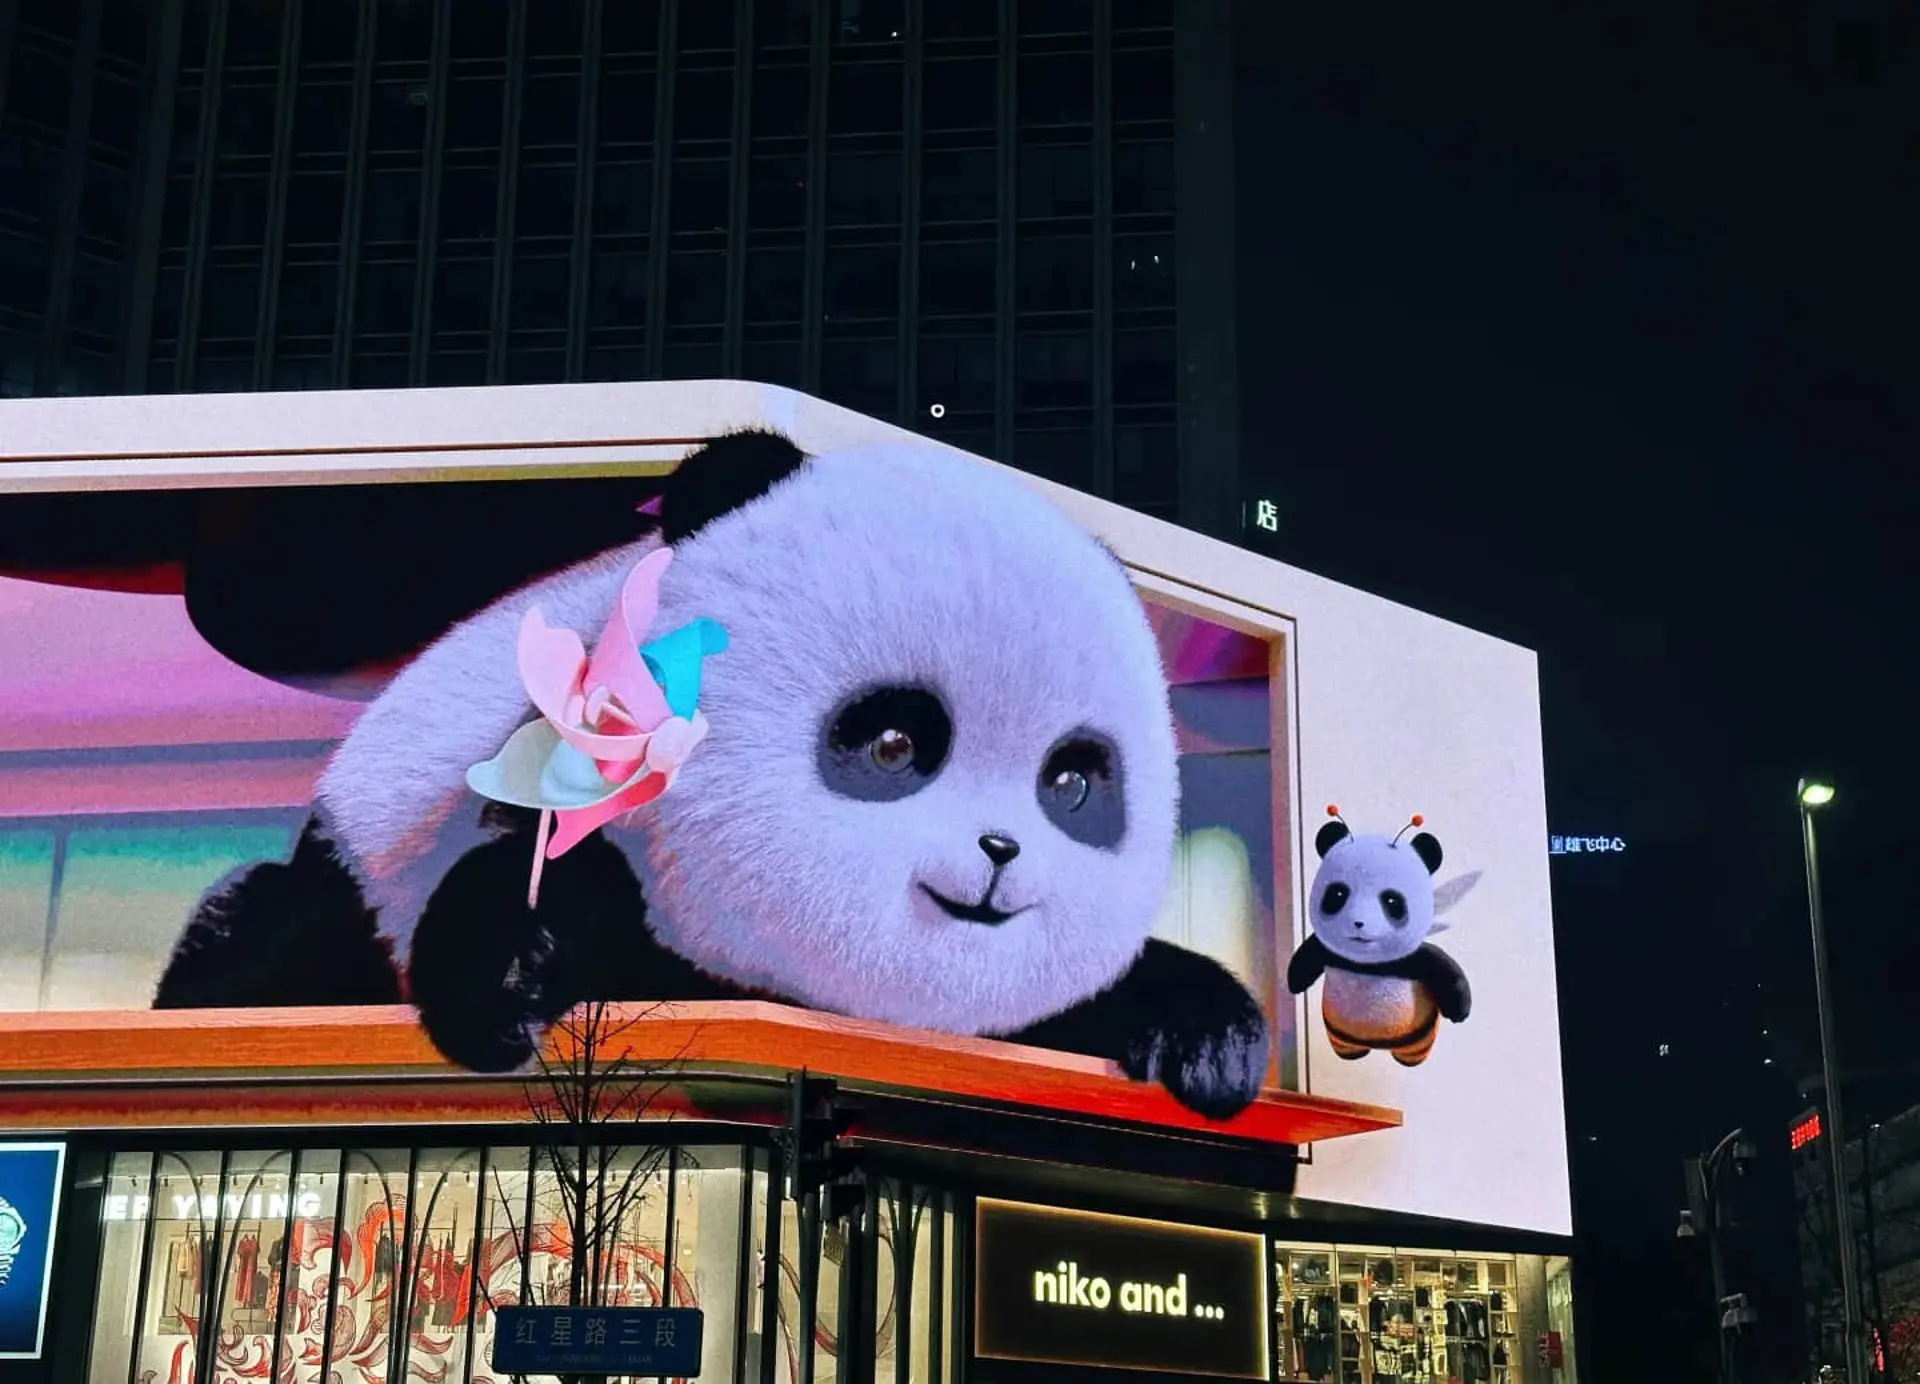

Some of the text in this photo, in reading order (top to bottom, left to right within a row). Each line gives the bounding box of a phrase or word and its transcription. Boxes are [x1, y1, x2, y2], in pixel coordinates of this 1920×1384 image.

[1256, 499, 1278, 532] 店
[1033, 1259, 1112, 1310] niko
[515, 1314, 678, 1349] 红星路三段
